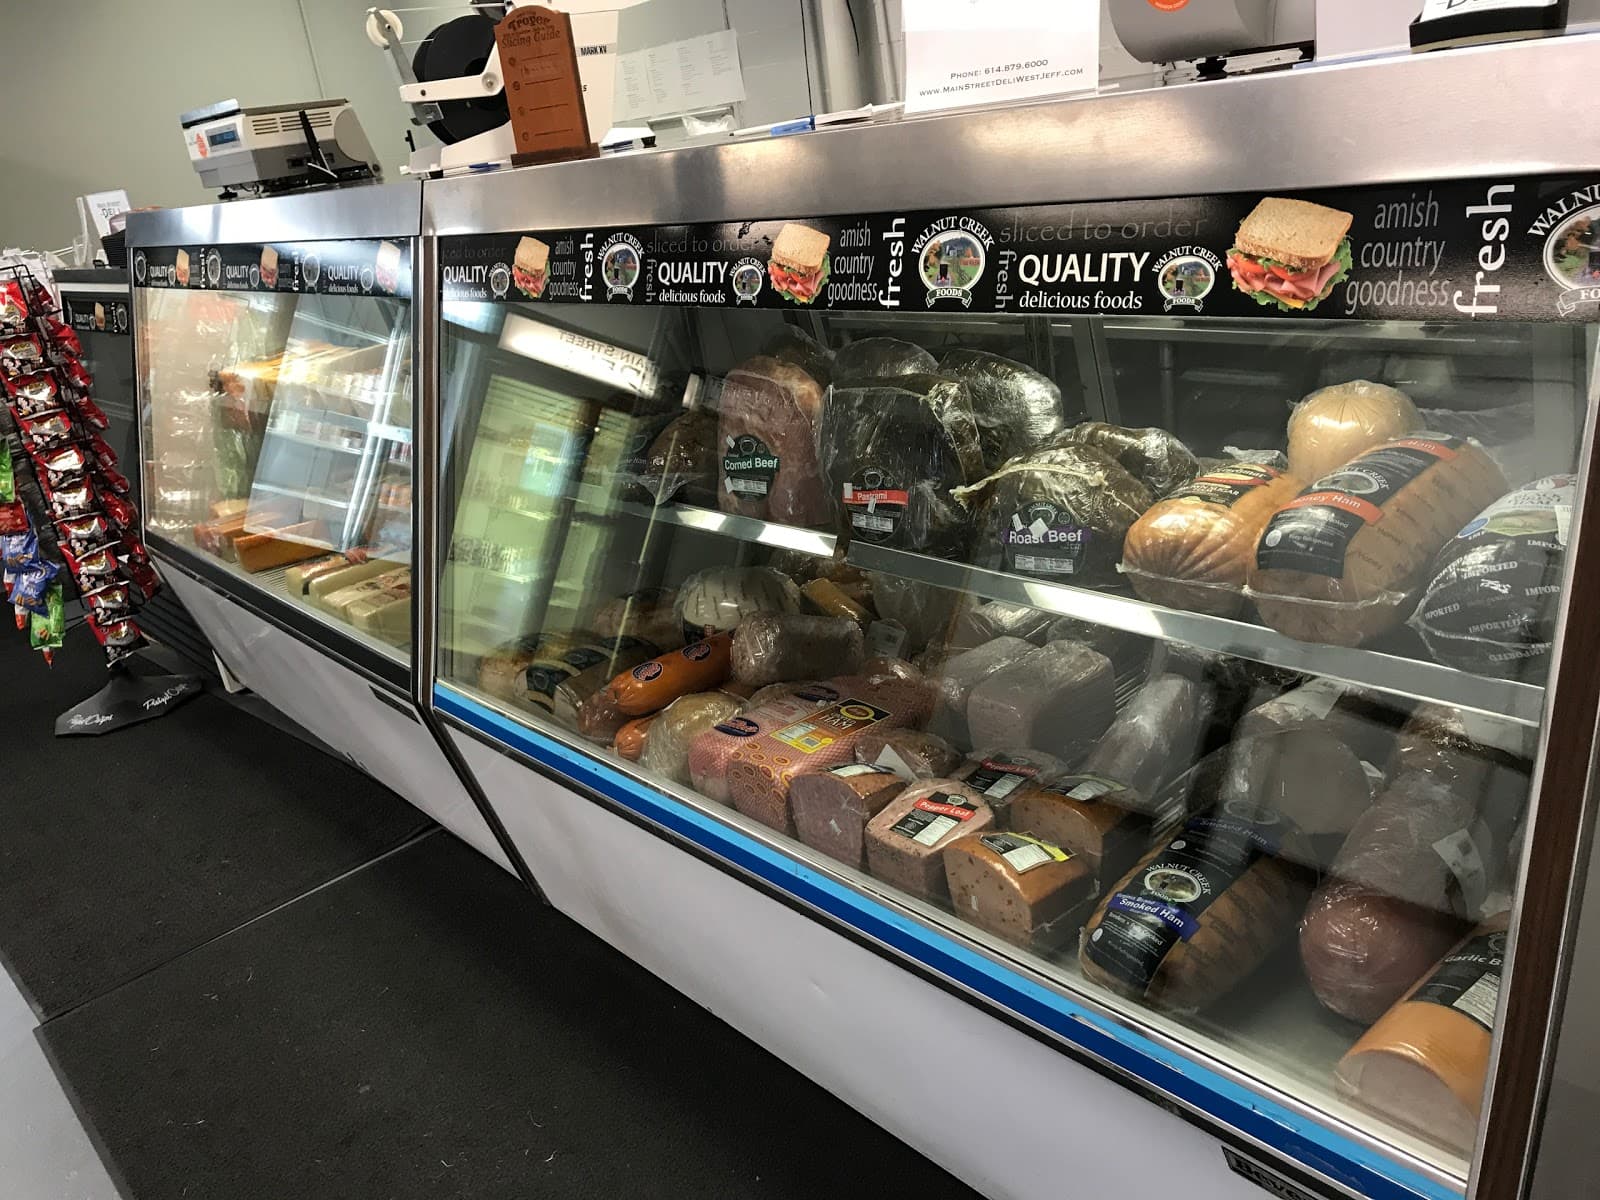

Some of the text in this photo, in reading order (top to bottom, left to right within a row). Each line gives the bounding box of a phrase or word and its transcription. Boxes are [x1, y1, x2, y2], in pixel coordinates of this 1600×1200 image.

[502, 36, 532, 49] Slicing
[534, 29, 561, 42] Guide
[581, 46, 599, 56] MARK
[984, 59, 1049, 75] 614.879.6000
[1374, 190, 1440, 229] amish
[840, 221, 871, 248] amish
[911, 216, 996, 255] WALNUT CREEK
[999, 209, 1208, 243] sliced to order
[554, 236, 575, 255] amish
[596, 232, 646, 261] WALNUT CREEK
[691, 232, 709, 253] to
[1453, 184, 1516, 317] fresh
[578, 232, 594, 303] fresh
[834, 255, 875, 281] country
[878, 217, 906, 309] fresh
[1151, 246, 1223, 274] WALNUT CREEK
[1360, 236, 1447, 277] country
[226, 265, 249, 278] QUALITY
[328, 264, 360, 281] QUALITY
[443, 265, 489, 284] QUALITY
[551, 258, 577, 281] country
[645, 258, 658, 303] fresh
[658, 261, 729, 286] QUALITY
[994, 249, 1018, 310] fresh
[1018, 252, 1150, 287] QUALITY
[549, 277, 580, 301] goodness
[658, 289, 726, 304] delicious foods
[827, 277, 878, 308] goodness
[935, 288, 964, 298] FOODS
[1018, 290, 1143, 310] delicious foods
[1345, 271, 1451, 315] goodness
[754, 457, 779, 469] Beef
[1332, 495, 1362, 509] Ham
[1008, 529, 1084, 545] Roast Beef
[919, 801, 970, 818] Pepper Loaf
[1146, 863, 1212, 896] WALNUT CREEK
[1119, 898, 1185, 928] Smoked Ham
